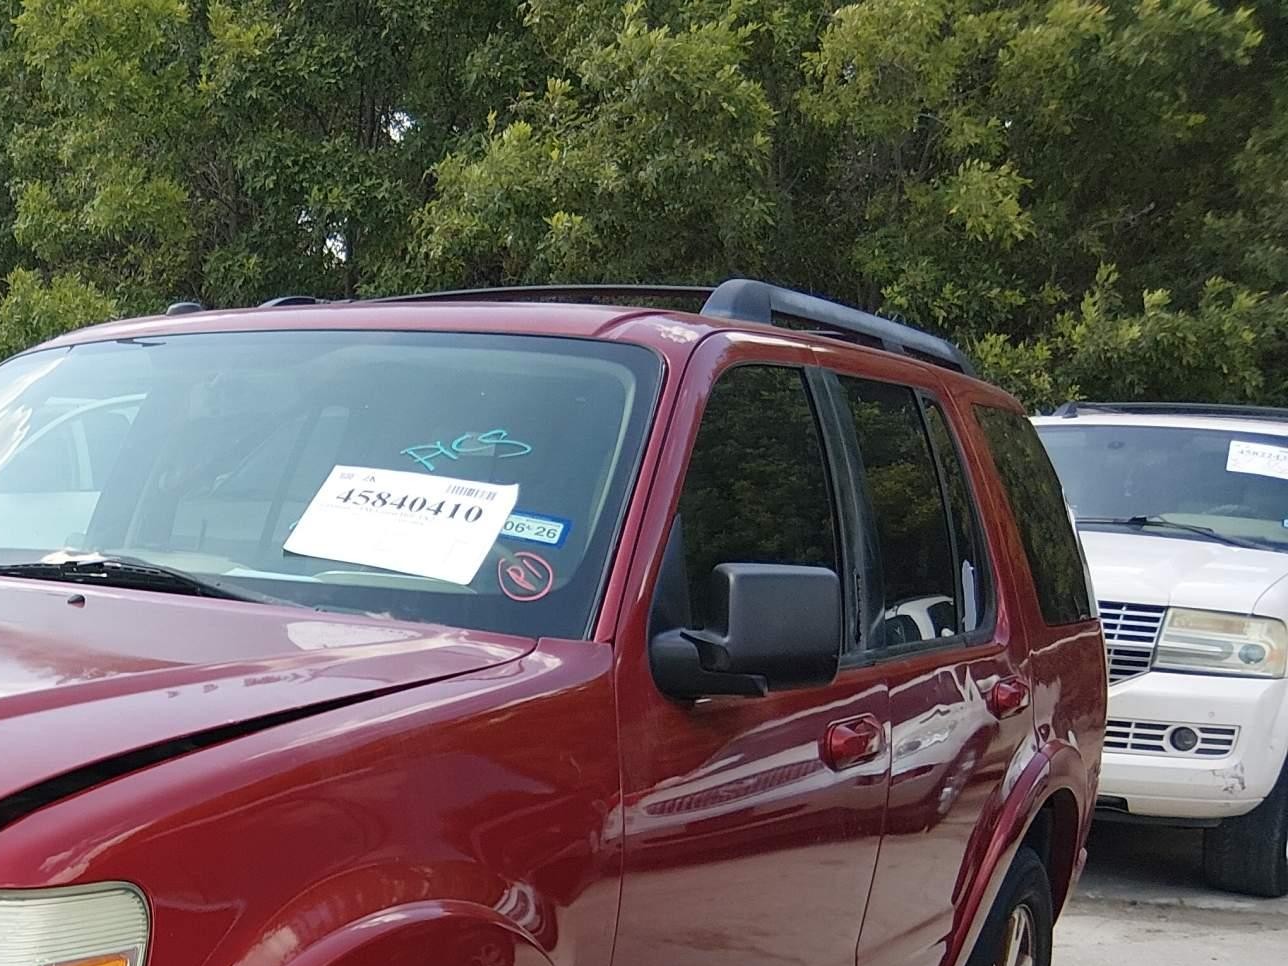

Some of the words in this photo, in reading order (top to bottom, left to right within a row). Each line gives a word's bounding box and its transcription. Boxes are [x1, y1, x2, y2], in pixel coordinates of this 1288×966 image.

[335, 487, 485, 524] 45840410
[502, 519, 525, 534] 06
[533, 525, 559, 540] 26
